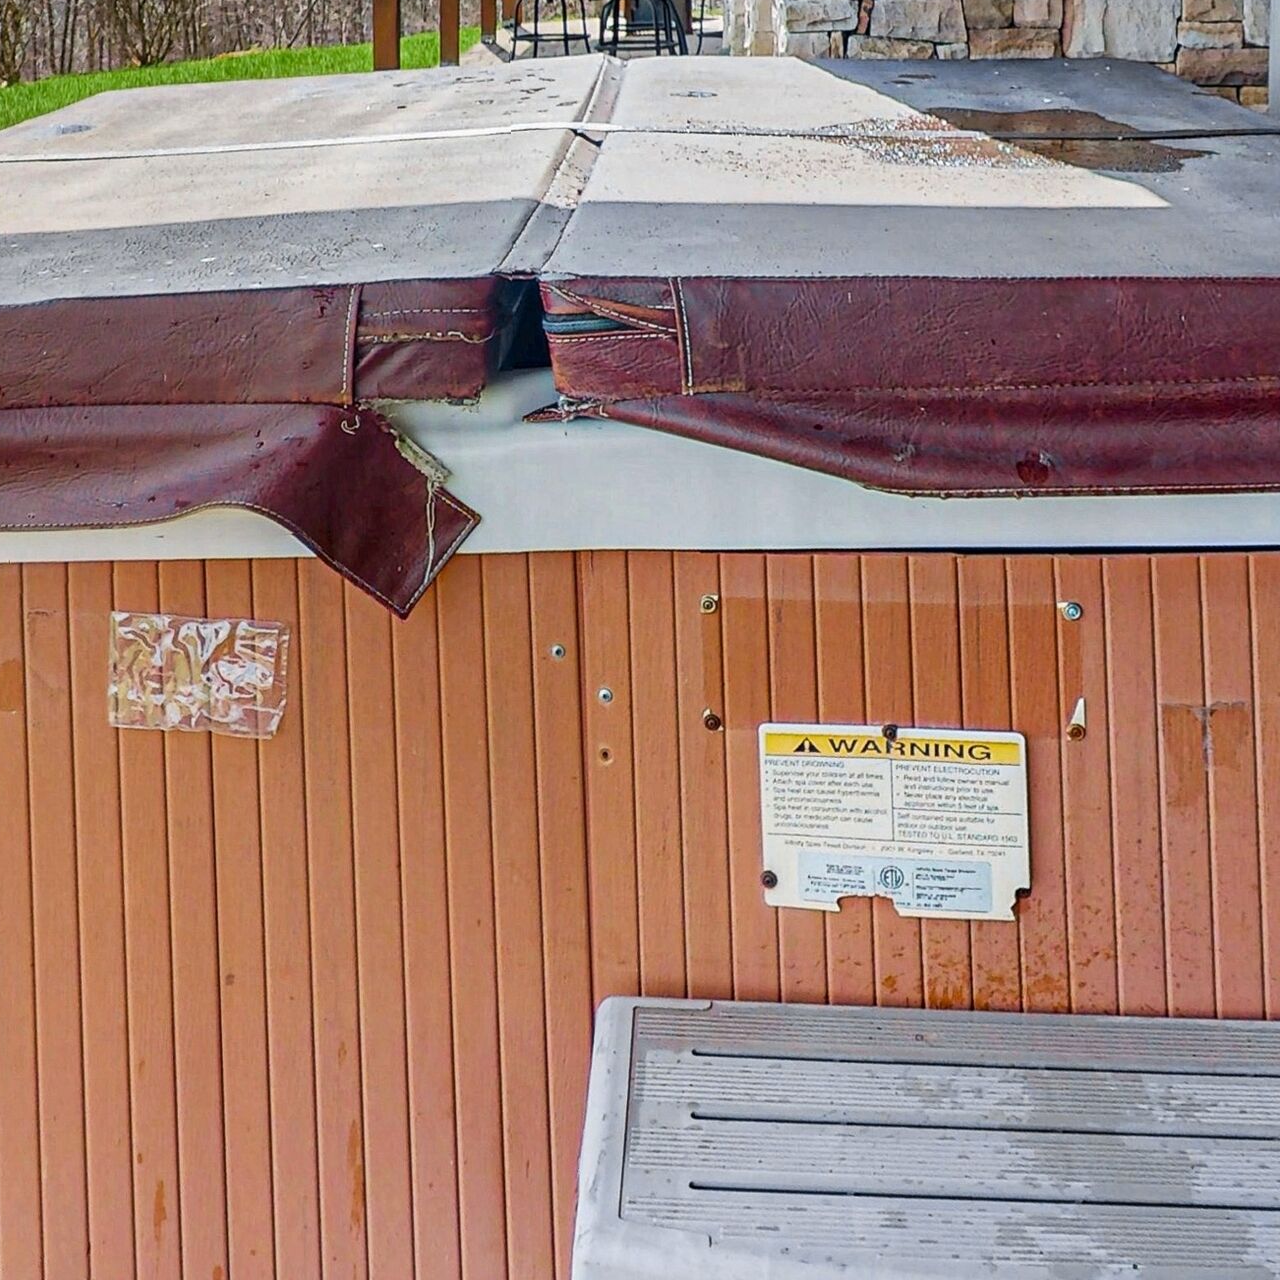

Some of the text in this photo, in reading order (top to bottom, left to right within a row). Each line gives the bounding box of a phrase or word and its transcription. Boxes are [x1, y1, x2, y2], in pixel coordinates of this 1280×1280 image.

[829, 738, 992, 761] WARNING
[896, 764, 1000, 775] PREVENT ELECTROCUTION
[903, 774, 921, 782] Read
[925, 793, 943, 801] place
[898, 830, 927, 839] TESTED
[957, 833, 999, 842] STANDARD
